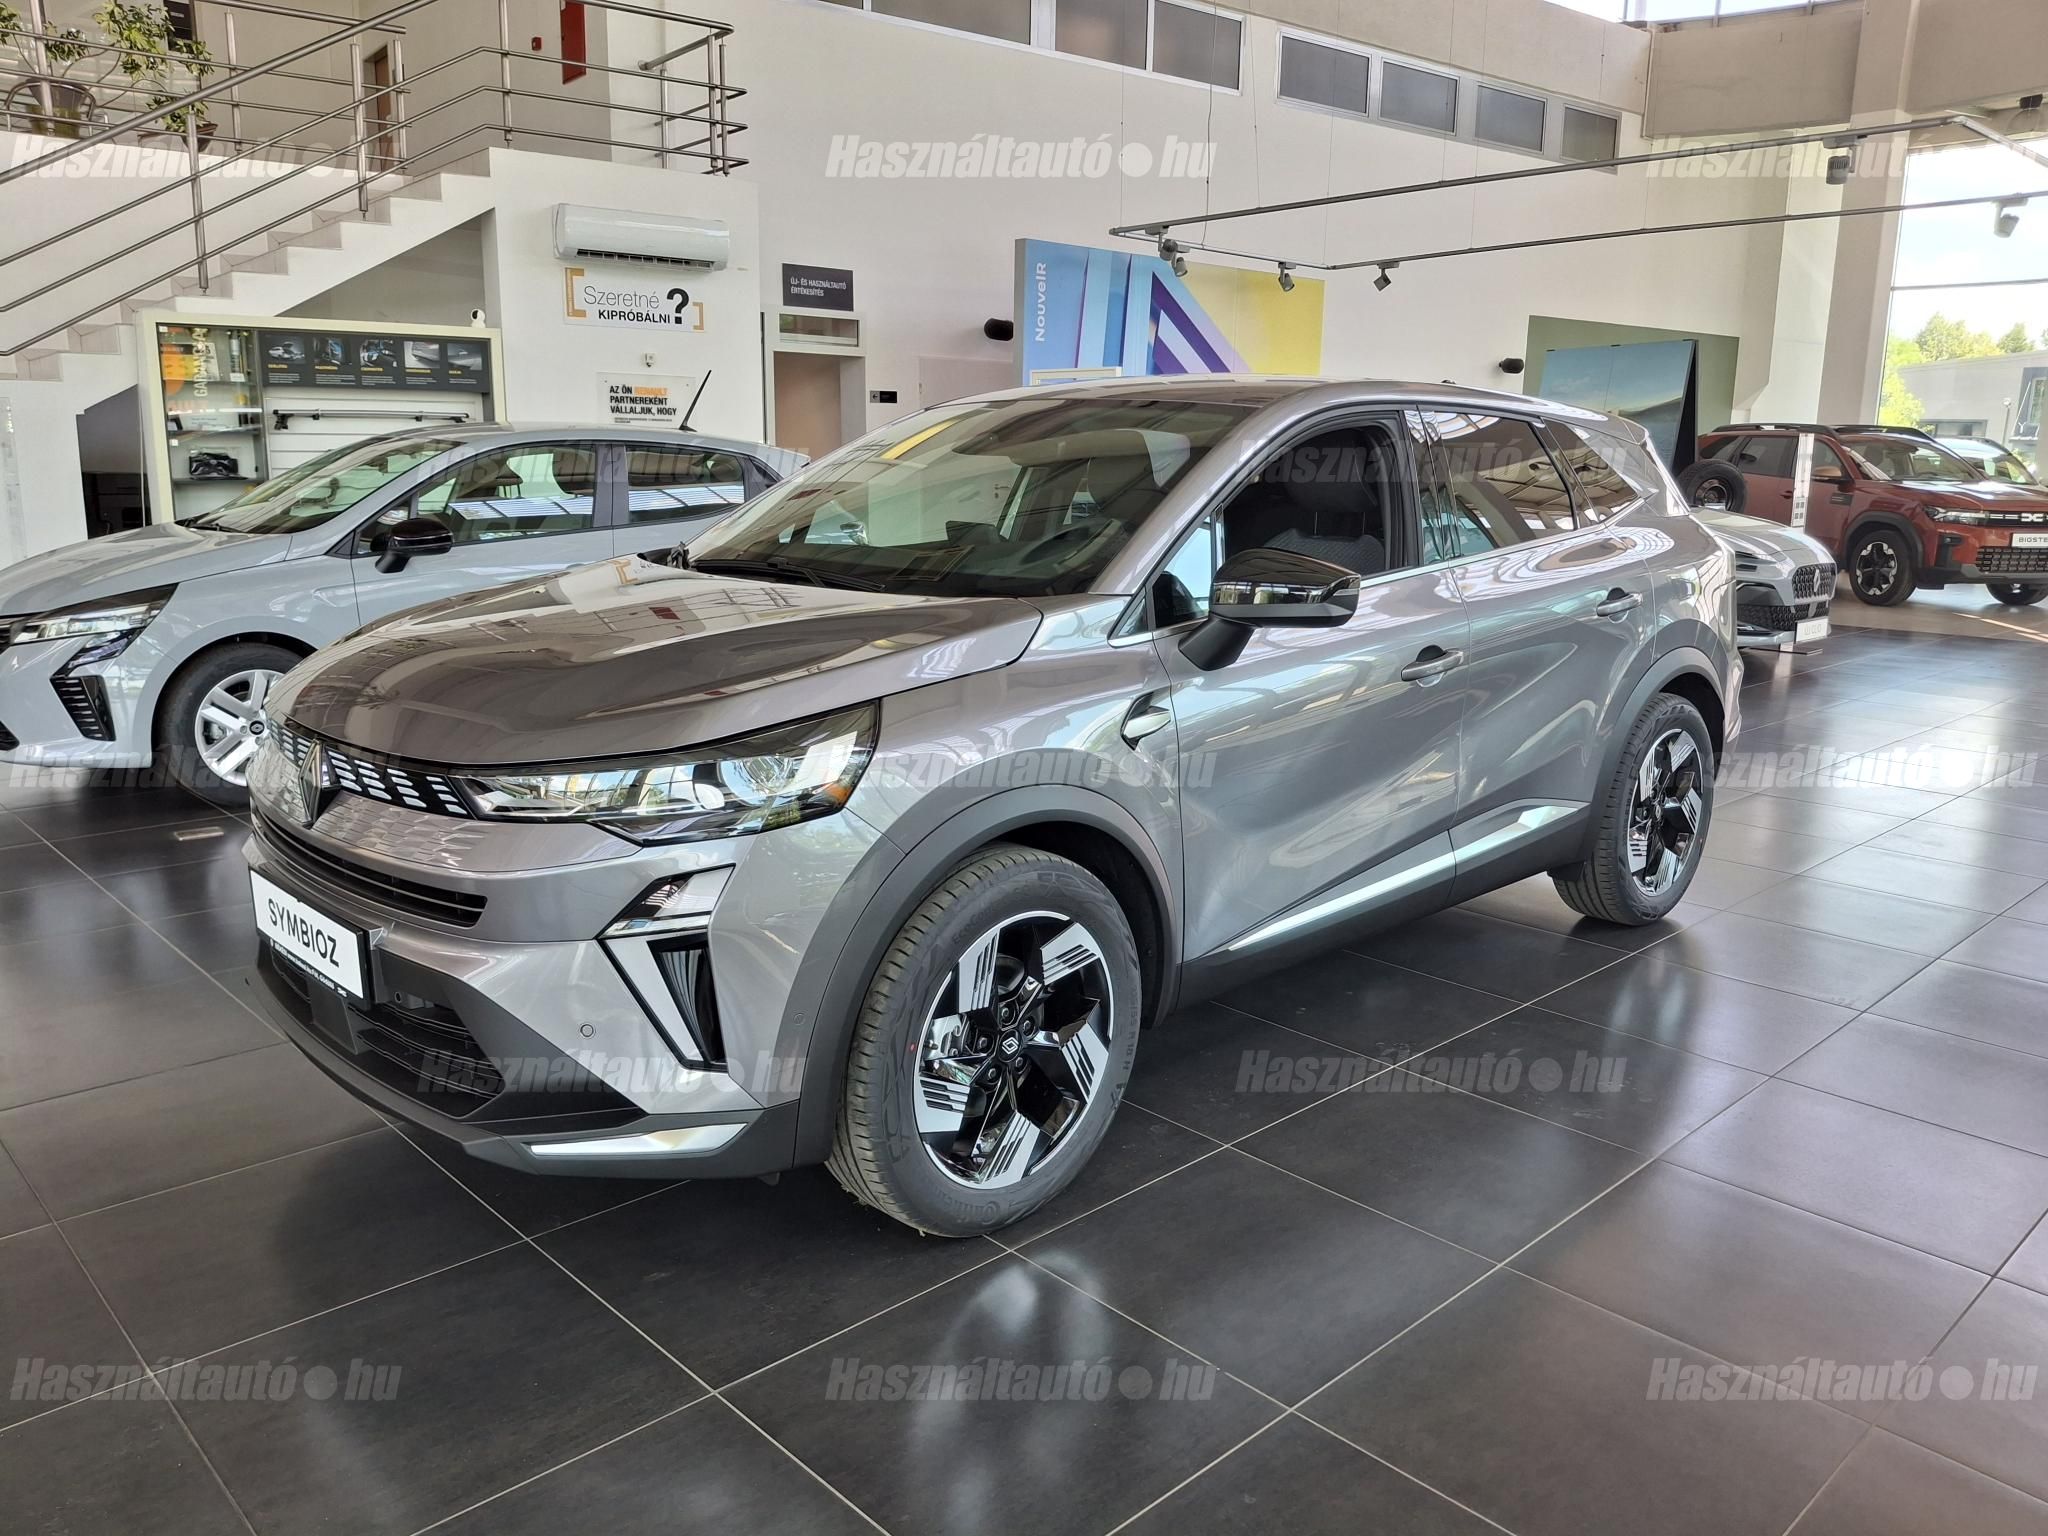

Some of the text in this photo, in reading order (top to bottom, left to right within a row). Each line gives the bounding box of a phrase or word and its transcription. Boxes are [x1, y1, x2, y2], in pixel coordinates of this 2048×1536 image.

[583, 285, 660, 309] Szeretné
[598, 309, 671, 324] KIPRÓBÁLNI
[622, 384, 632, 394] ÖN
[610, 396, 668, 405] PARTNEREKÉNT
[610, 405, 677, 416] VÁLLALJUK, HOGY
[268, 898, 340, 968] SYMBIOZ
